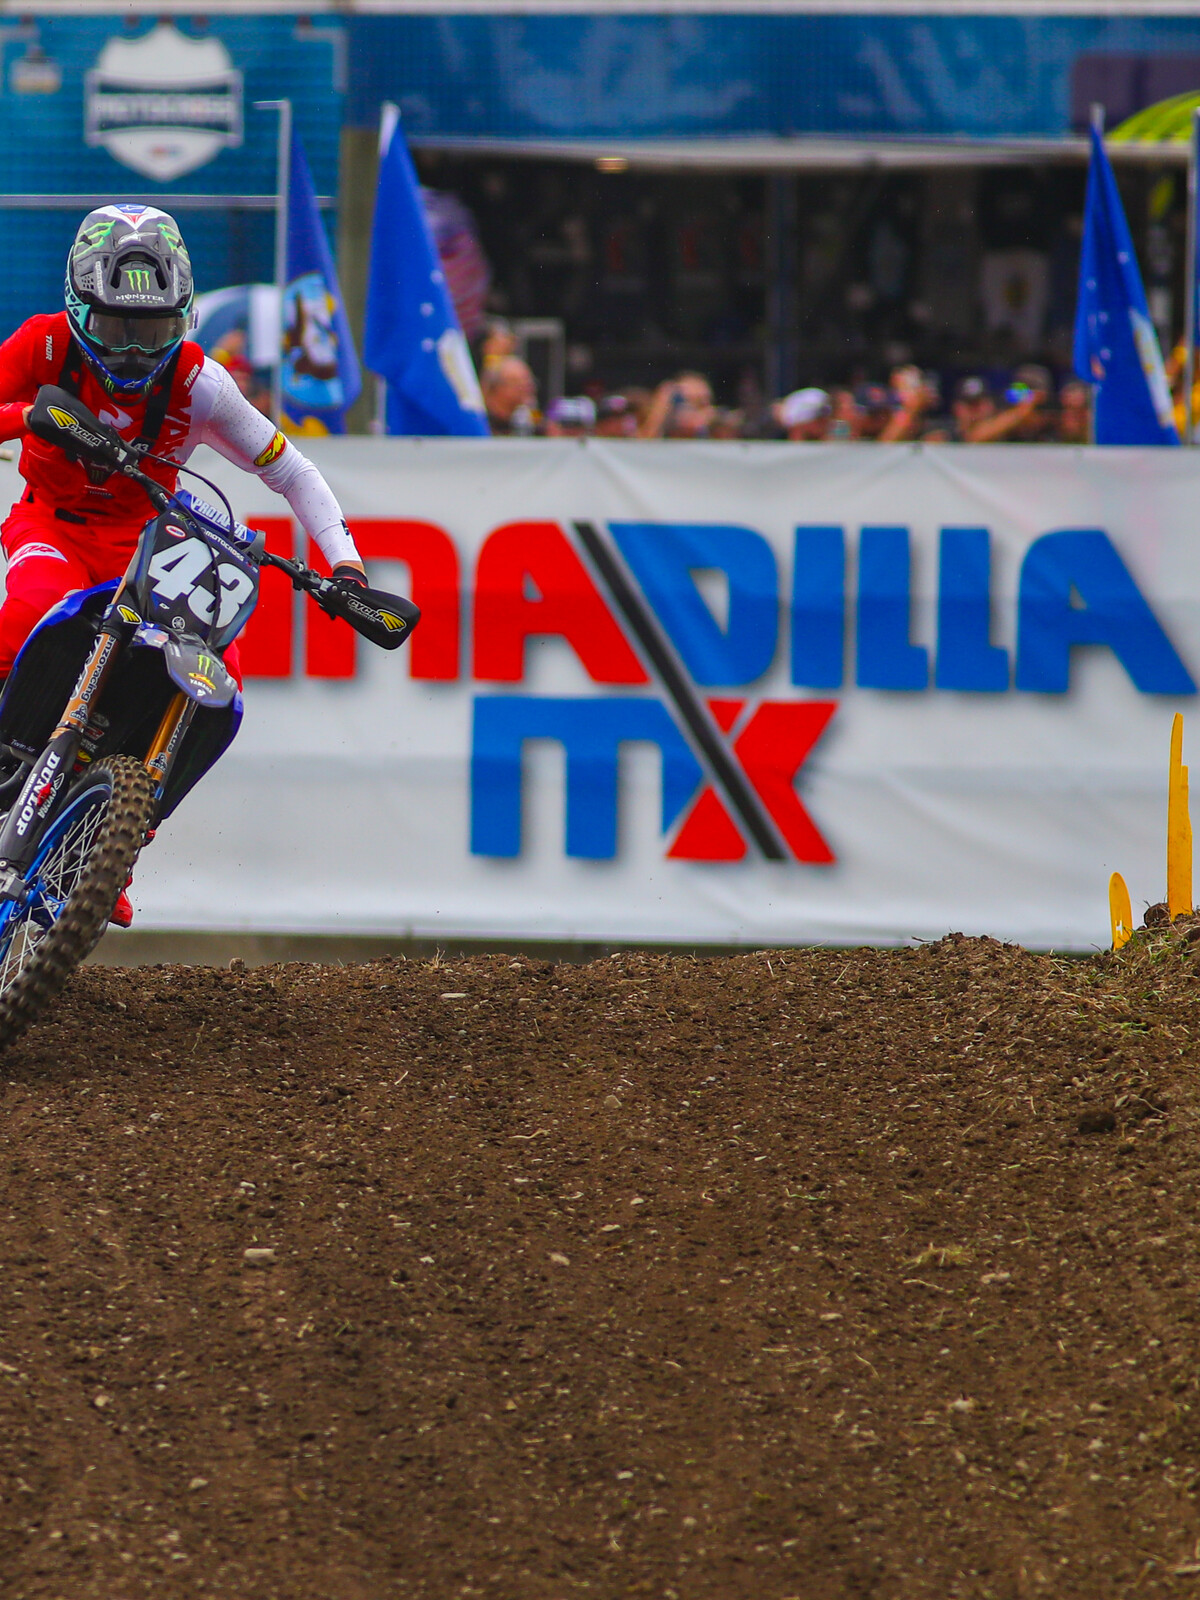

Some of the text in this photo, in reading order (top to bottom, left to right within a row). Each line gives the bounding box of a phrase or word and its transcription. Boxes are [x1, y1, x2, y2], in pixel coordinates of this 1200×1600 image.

[115, 293, 165, 303] MONSTER
[45, 335, 53, 361] THOR
[183, 363, 201, 389] THOR
[68, 423, 102, 447] CYCRA
[147, 536, 255, 628] 43
[347, 598, 386, 622] CYCRA
[80, 635, 117, 703] enzoracing
[15, 751, 61, 837] DUNLOP
[18, 773, 38, 806] BRAKING
[469, 695, 841, 865] MX
[37, 787, 58, 819] CYCRA
